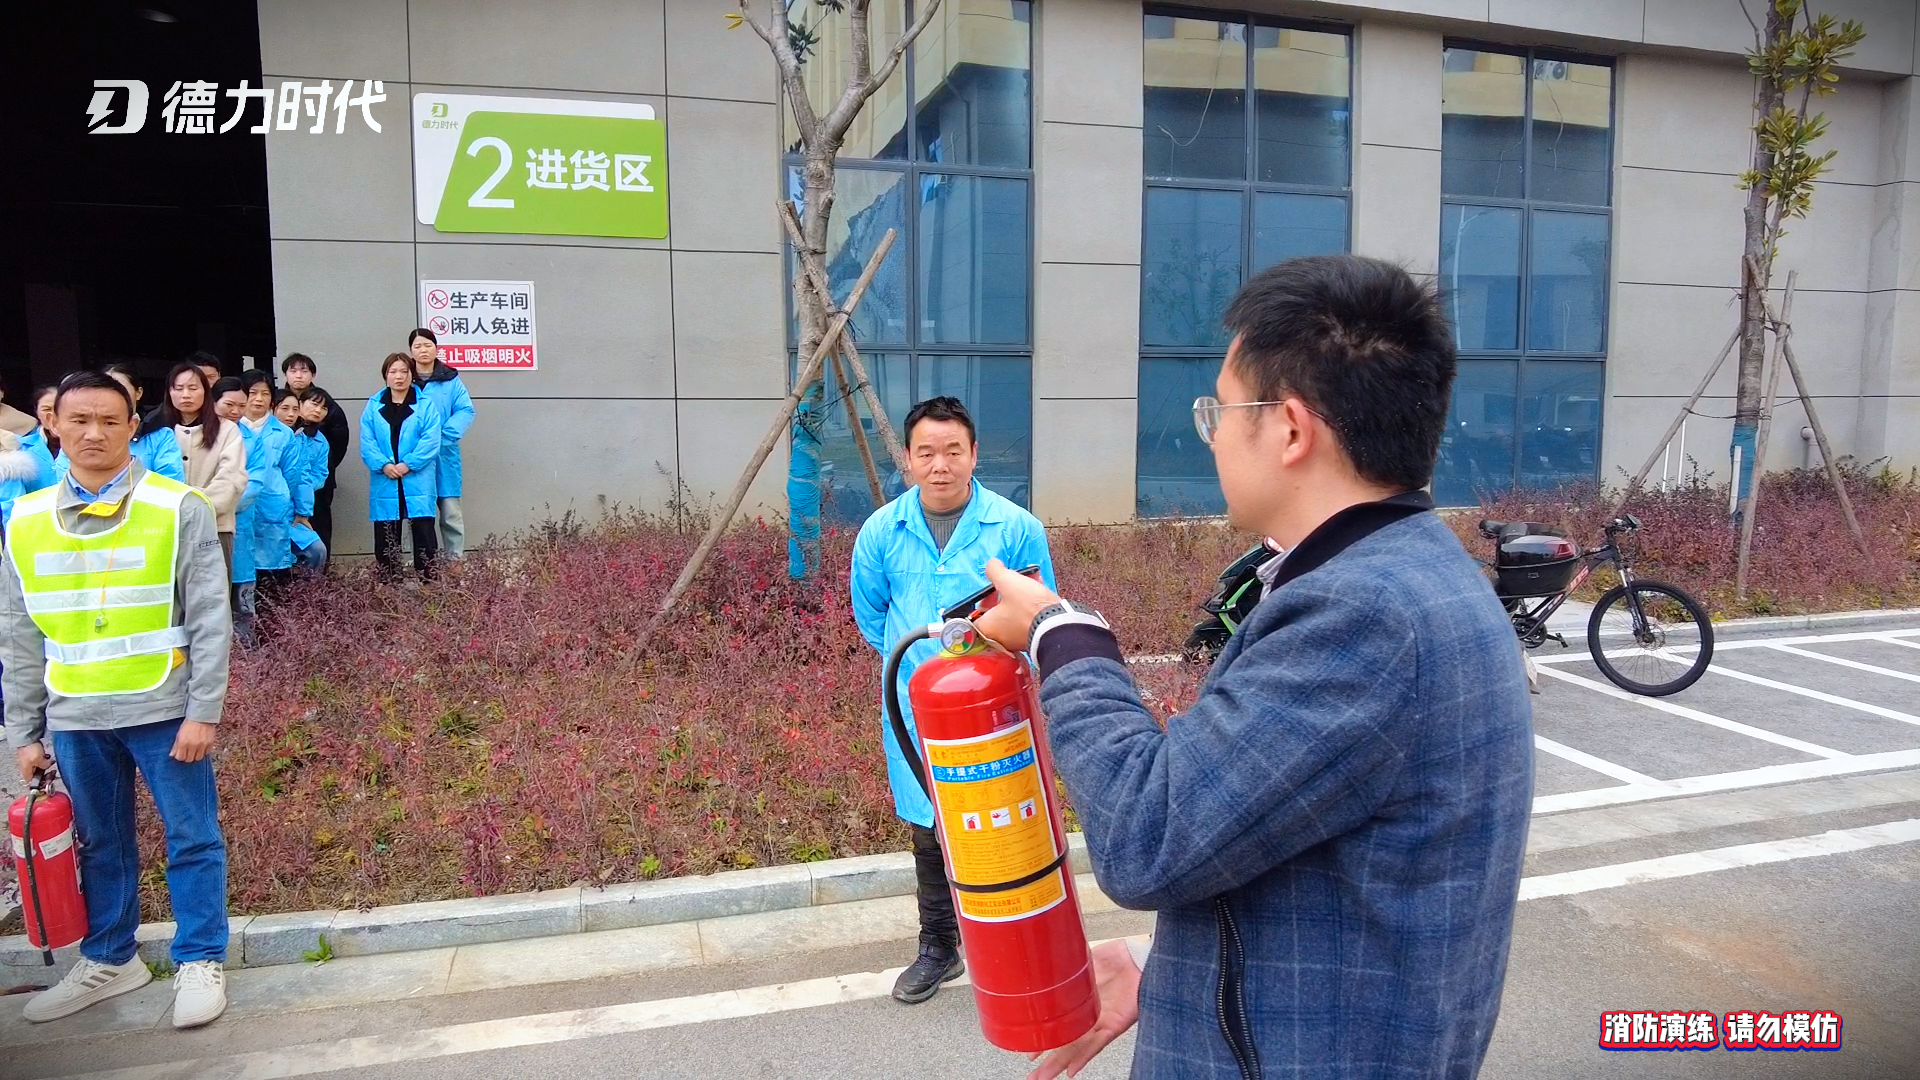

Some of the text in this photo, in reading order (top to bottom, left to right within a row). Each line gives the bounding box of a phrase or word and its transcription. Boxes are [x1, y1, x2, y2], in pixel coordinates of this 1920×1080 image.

[421, 119, 459, 131] 德力时代
[466, 136, 654, 209] 2 进货区
[450, 291, 529, 310] 生产车间
[450, 317, 530, 335] 闲人免进
[946, 749, 1031, 777] 手提式干粉灭火器
